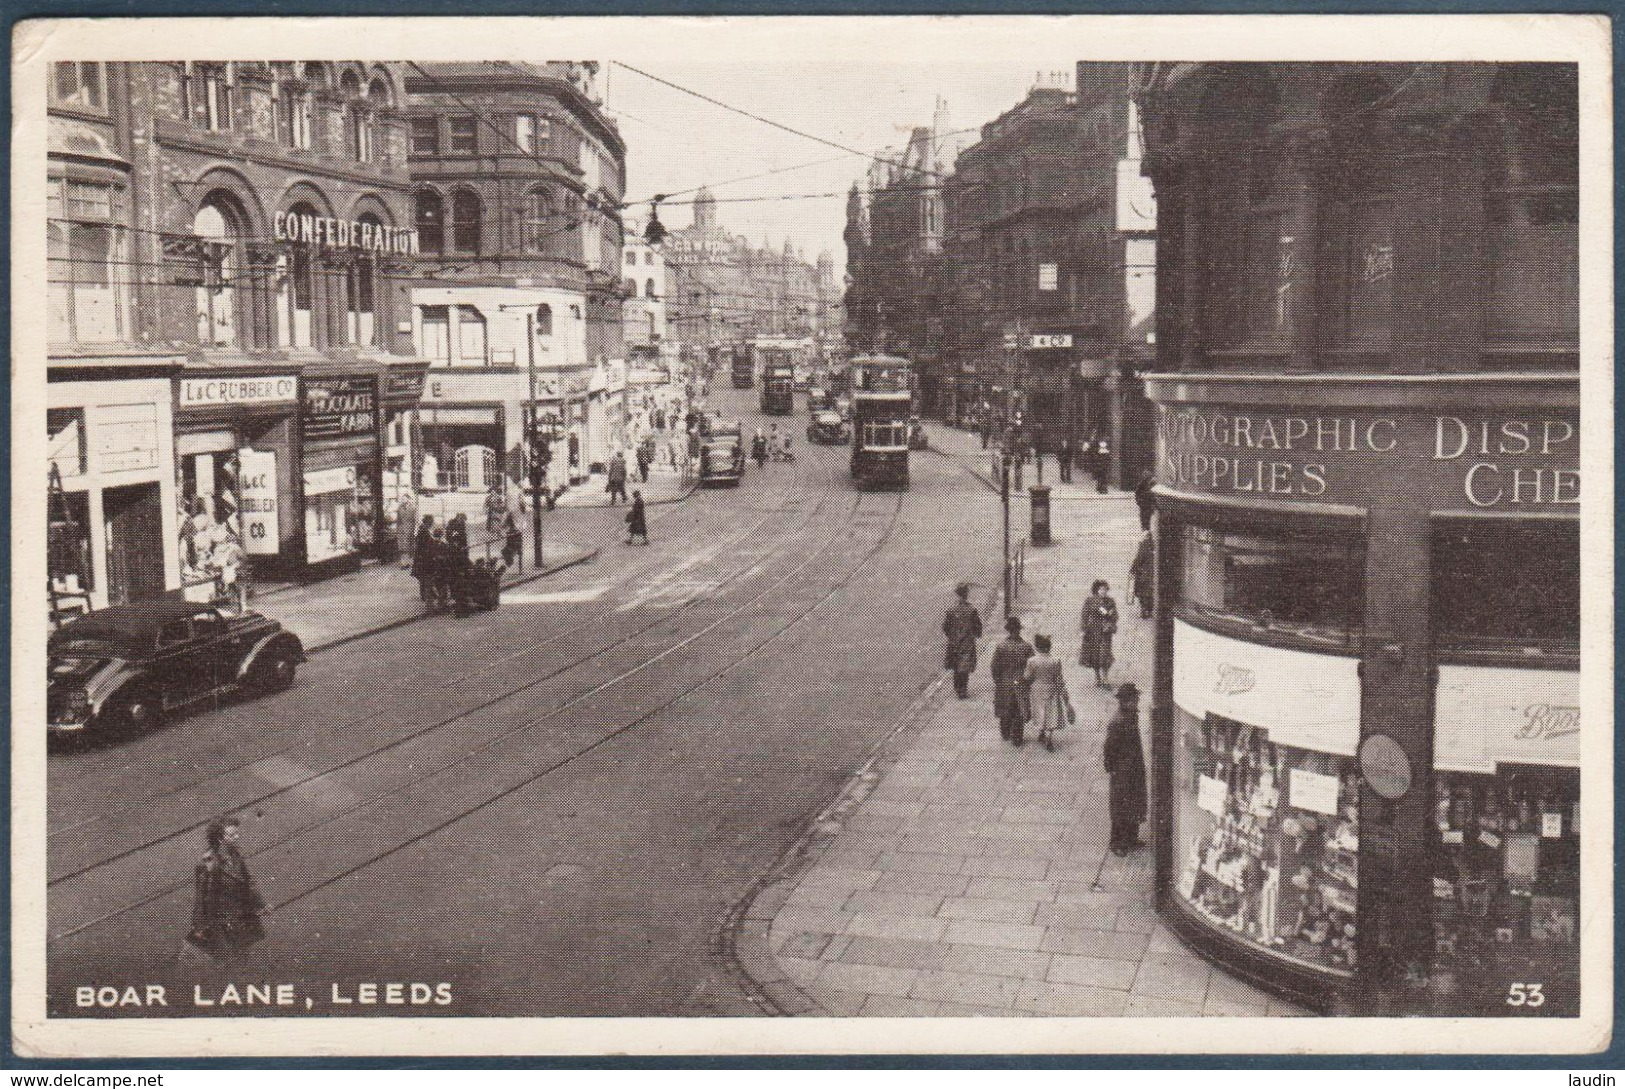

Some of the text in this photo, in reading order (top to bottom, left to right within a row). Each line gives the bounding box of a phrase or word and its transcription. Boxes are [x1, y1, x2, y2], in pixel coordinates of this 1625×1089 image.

[274, 211, 420, 254] CONFEDERATION
[219, 381, 273, 402] RUBBER
[306, 393, 373, 413] HOCOLATE
[1157, 411, 1397, 451] OTOGRAPHIC
[1433, 416, 1572, 459] DISP
[1168, 455, 1327, 496] SUPPLIES
[1465, 463, 1580, 507] CHE
